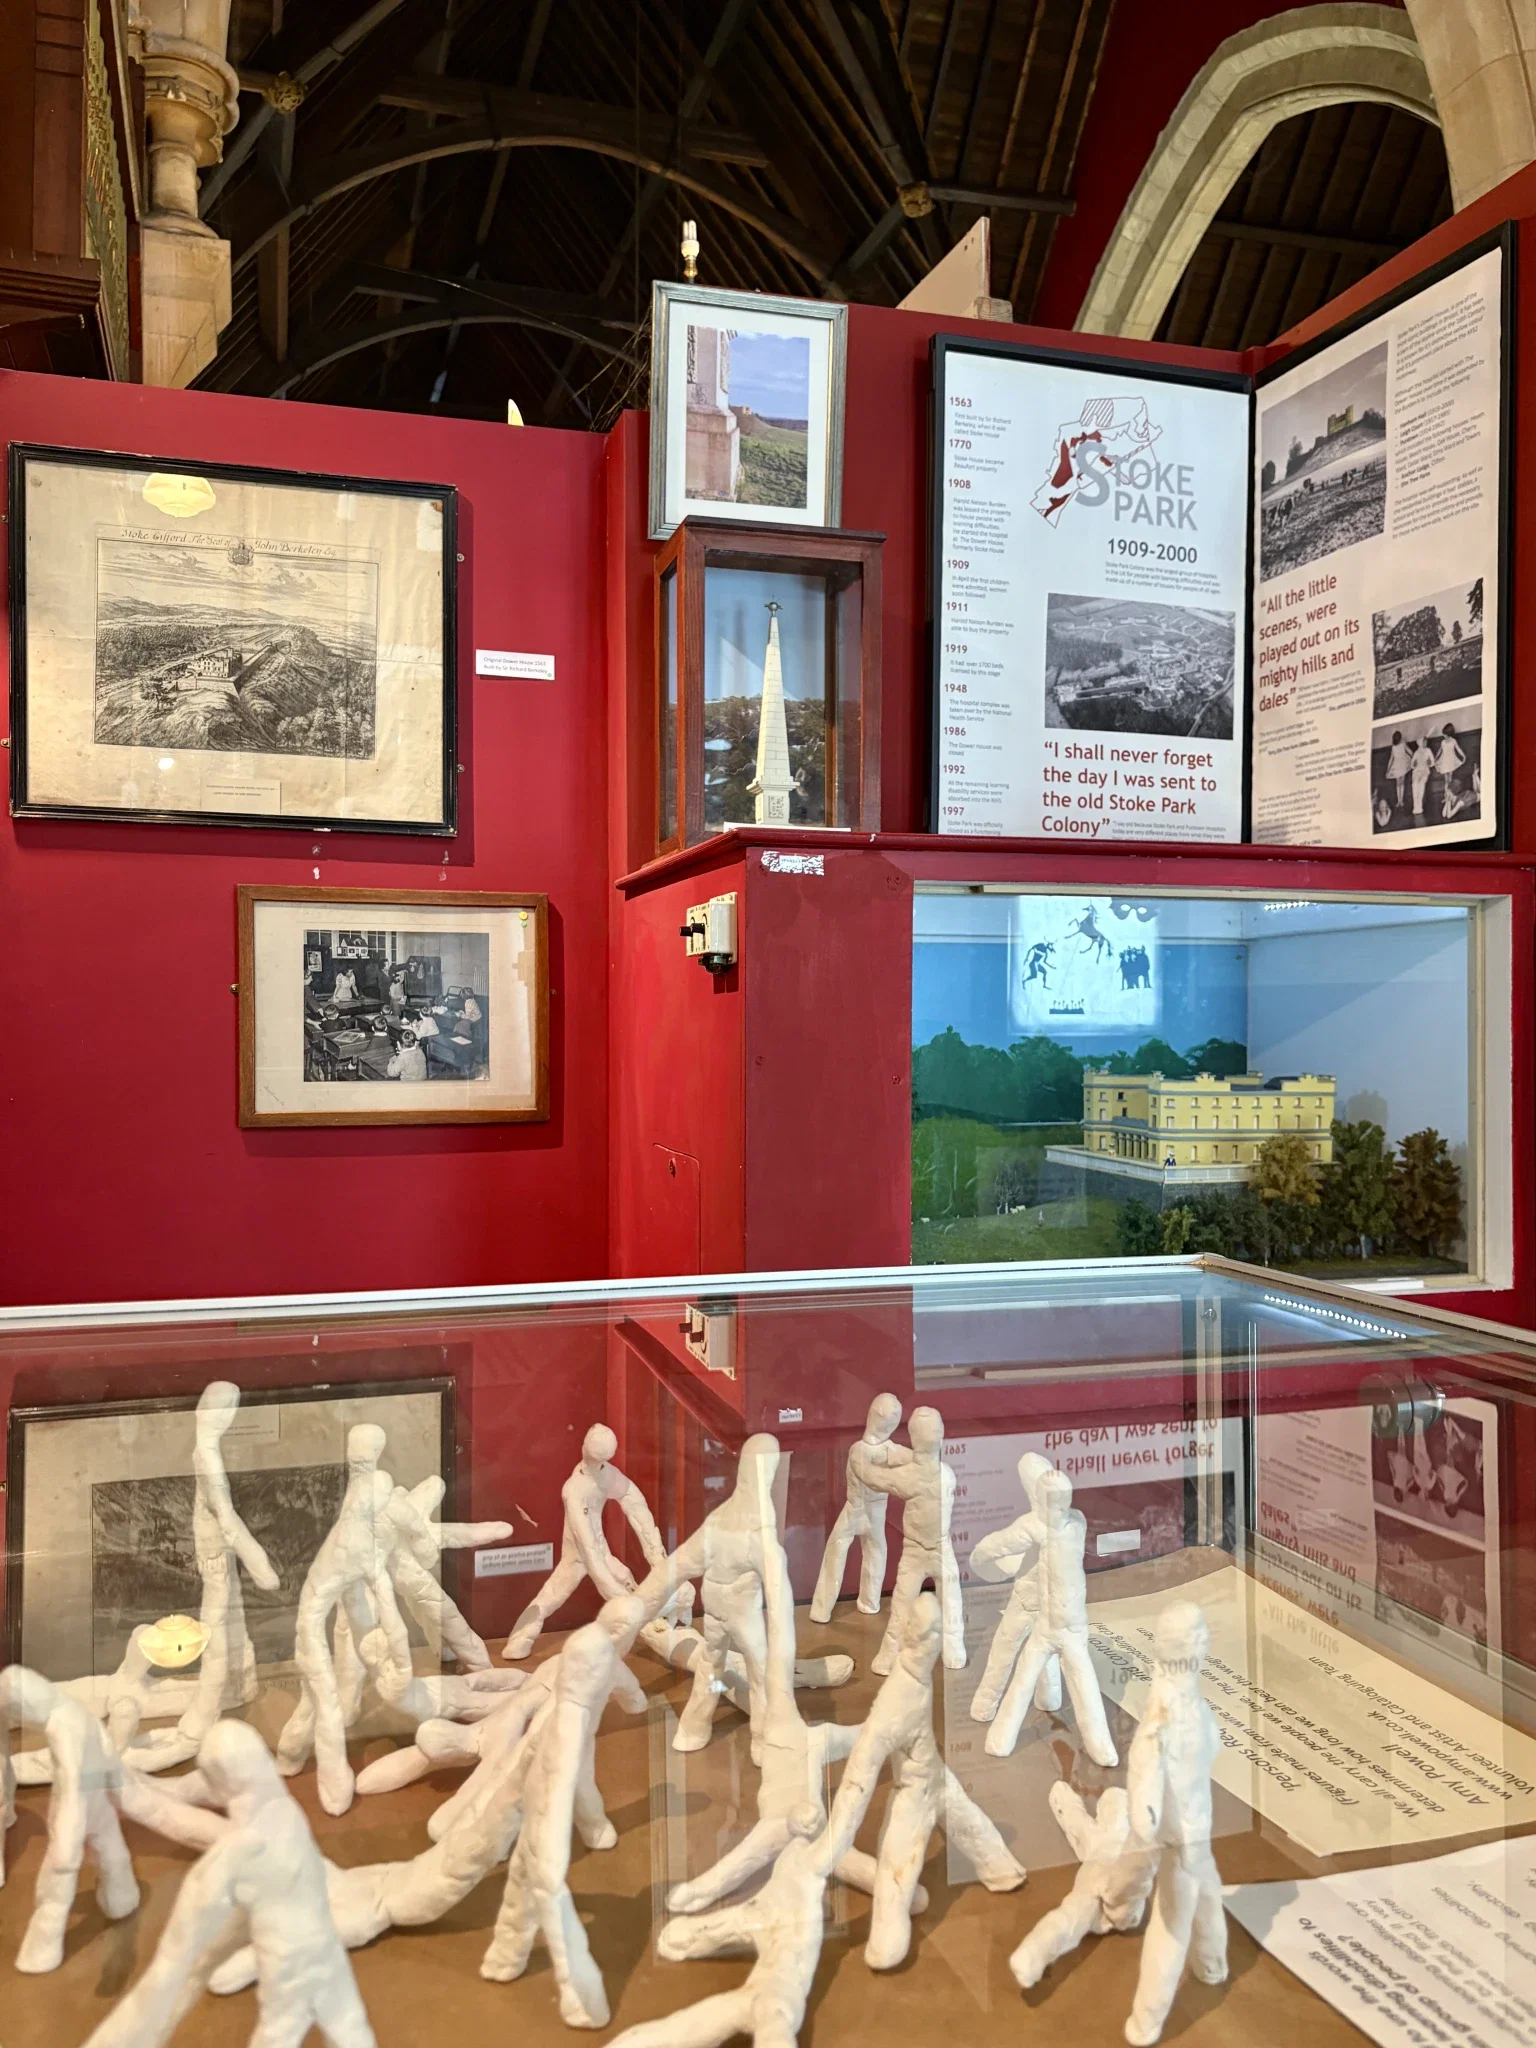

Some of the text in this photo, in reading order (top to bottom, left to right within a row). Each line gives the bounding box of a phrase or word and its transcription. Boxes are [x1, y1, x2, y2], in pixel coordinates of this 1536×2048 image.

[950, 397, 972, 407] 1563
[949, 439, 971, 449] 1770
[1075, 442, 1194, 506] STOKE
[948, 479, 971, 489] 1908
[1114, 490, 1198, 531] PARK
[1108, 538, 1198, 563] 1909-2000
[947, 560, 969, 569] 1909
[1285, 589, 1304, 606] the
[1308, 575, 1337, 598] little
[947, 602, 968, 611] 1911
[1259, 602, 1337, 640] scenes, were
[946, 644, 967, 653] 1919
[1259, 619, 1360, 668] played out on its
[1260, 643, 1354, 688] mighty hills and
[945, 684, 967, 693] 1948
[944, 727, 966, 736] 1986
[1065, 744, 1103, 760] shall
[1111, 749, 1158, 763] never
[1164, 749, 1213, 769] forget
[943, 765, 965, 774] 1992
[1043, 767, 1217, 791] the day I was sent to
[943, 806, 964, 815] 1997
[1043, 791, 1196, 814] the old Stoke Park
[1121, 1667, 1152, 1682] and
[1232, 1675, 1252, 1686] the
[1217, 1682, 1238, 1695] The
[1249, 1688, 1276, 1702] bear
[1240, 1696, 1265, 1712] love.
[1275, 1702, 1297, 1716] can
[1219, 1712, 1245, 1728] wire
[1263, 1713, 1282, 1724] we
[1295, 1716, 1315, 1728] we
[1309, 1656, 1534, 1794] Volunteer Artist and Cataloguing Team
[1243, 1728, 1273, 1748] from
[1281, 1725, 1326, 1751] people
[1313, 1728, 1343, 1746] long
[1271, 1748, 1307, 1771] made
[1321, 1752, 1344, 1766] the
[1339, 1747, 1371, 1764] how
[1368, 1710, 1512, 1800] www.amypowell.co.uk
[1341, 1767, 1378, 1788] carry
[1381, 1744, 1490, 1805] Amy Powell
[1304, 1771, 1359, 1805] (Figures
[1368, 1765, 1444, 1812] determines
[1371, 1789, 1396, 1800] all
[1394, 1801, 1419, 1817] We
